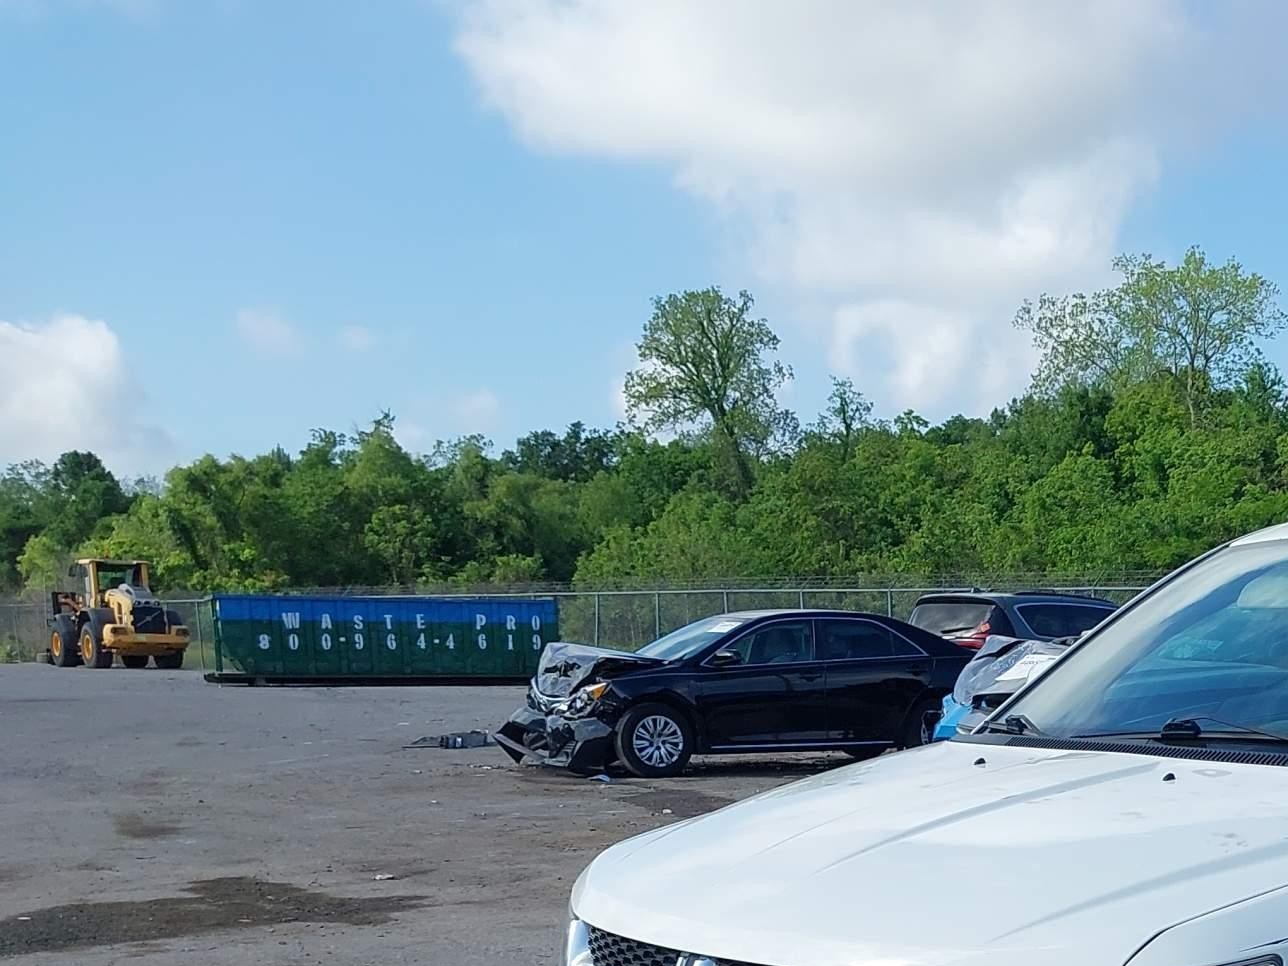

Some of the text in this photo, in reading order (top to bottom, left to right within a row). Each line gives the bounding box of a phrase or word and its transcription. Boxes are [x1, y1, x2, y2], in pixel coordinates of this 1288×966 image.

[281, 612, 541, 631] WASTE PRO
[258, 633, 542, 651] 800-964-4619
